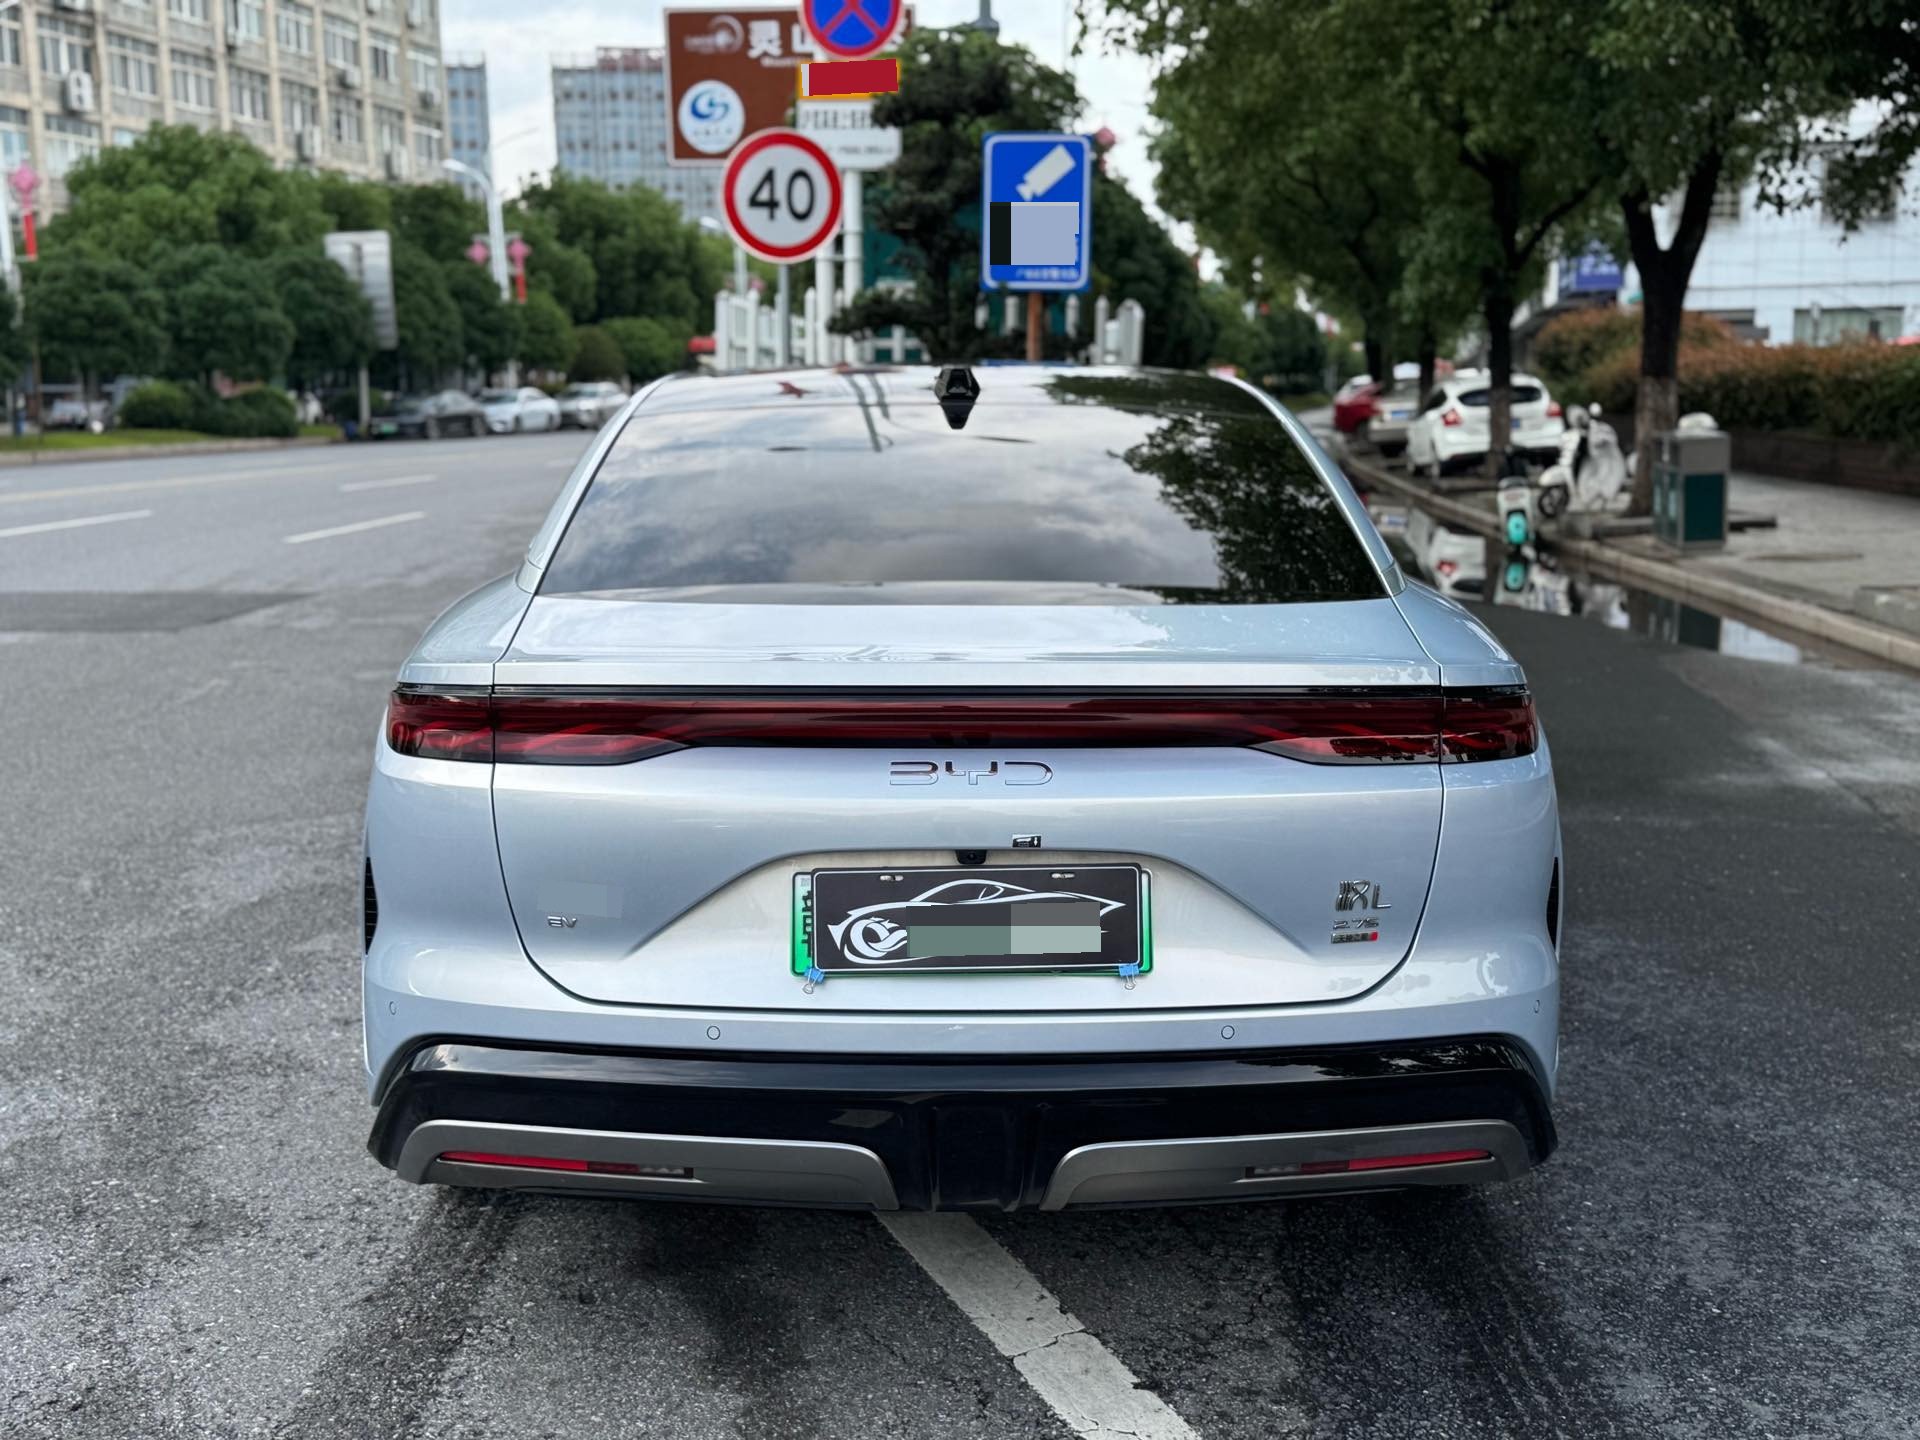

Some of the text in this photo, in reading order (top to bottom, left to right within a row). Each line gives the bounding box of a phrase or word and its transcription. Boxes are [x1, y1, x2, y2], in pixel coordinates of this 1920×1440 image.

[749, 167, 815, 221] 40
[890, 761, 1053, 785] BYD
[547, 916, 577, 928] EV
